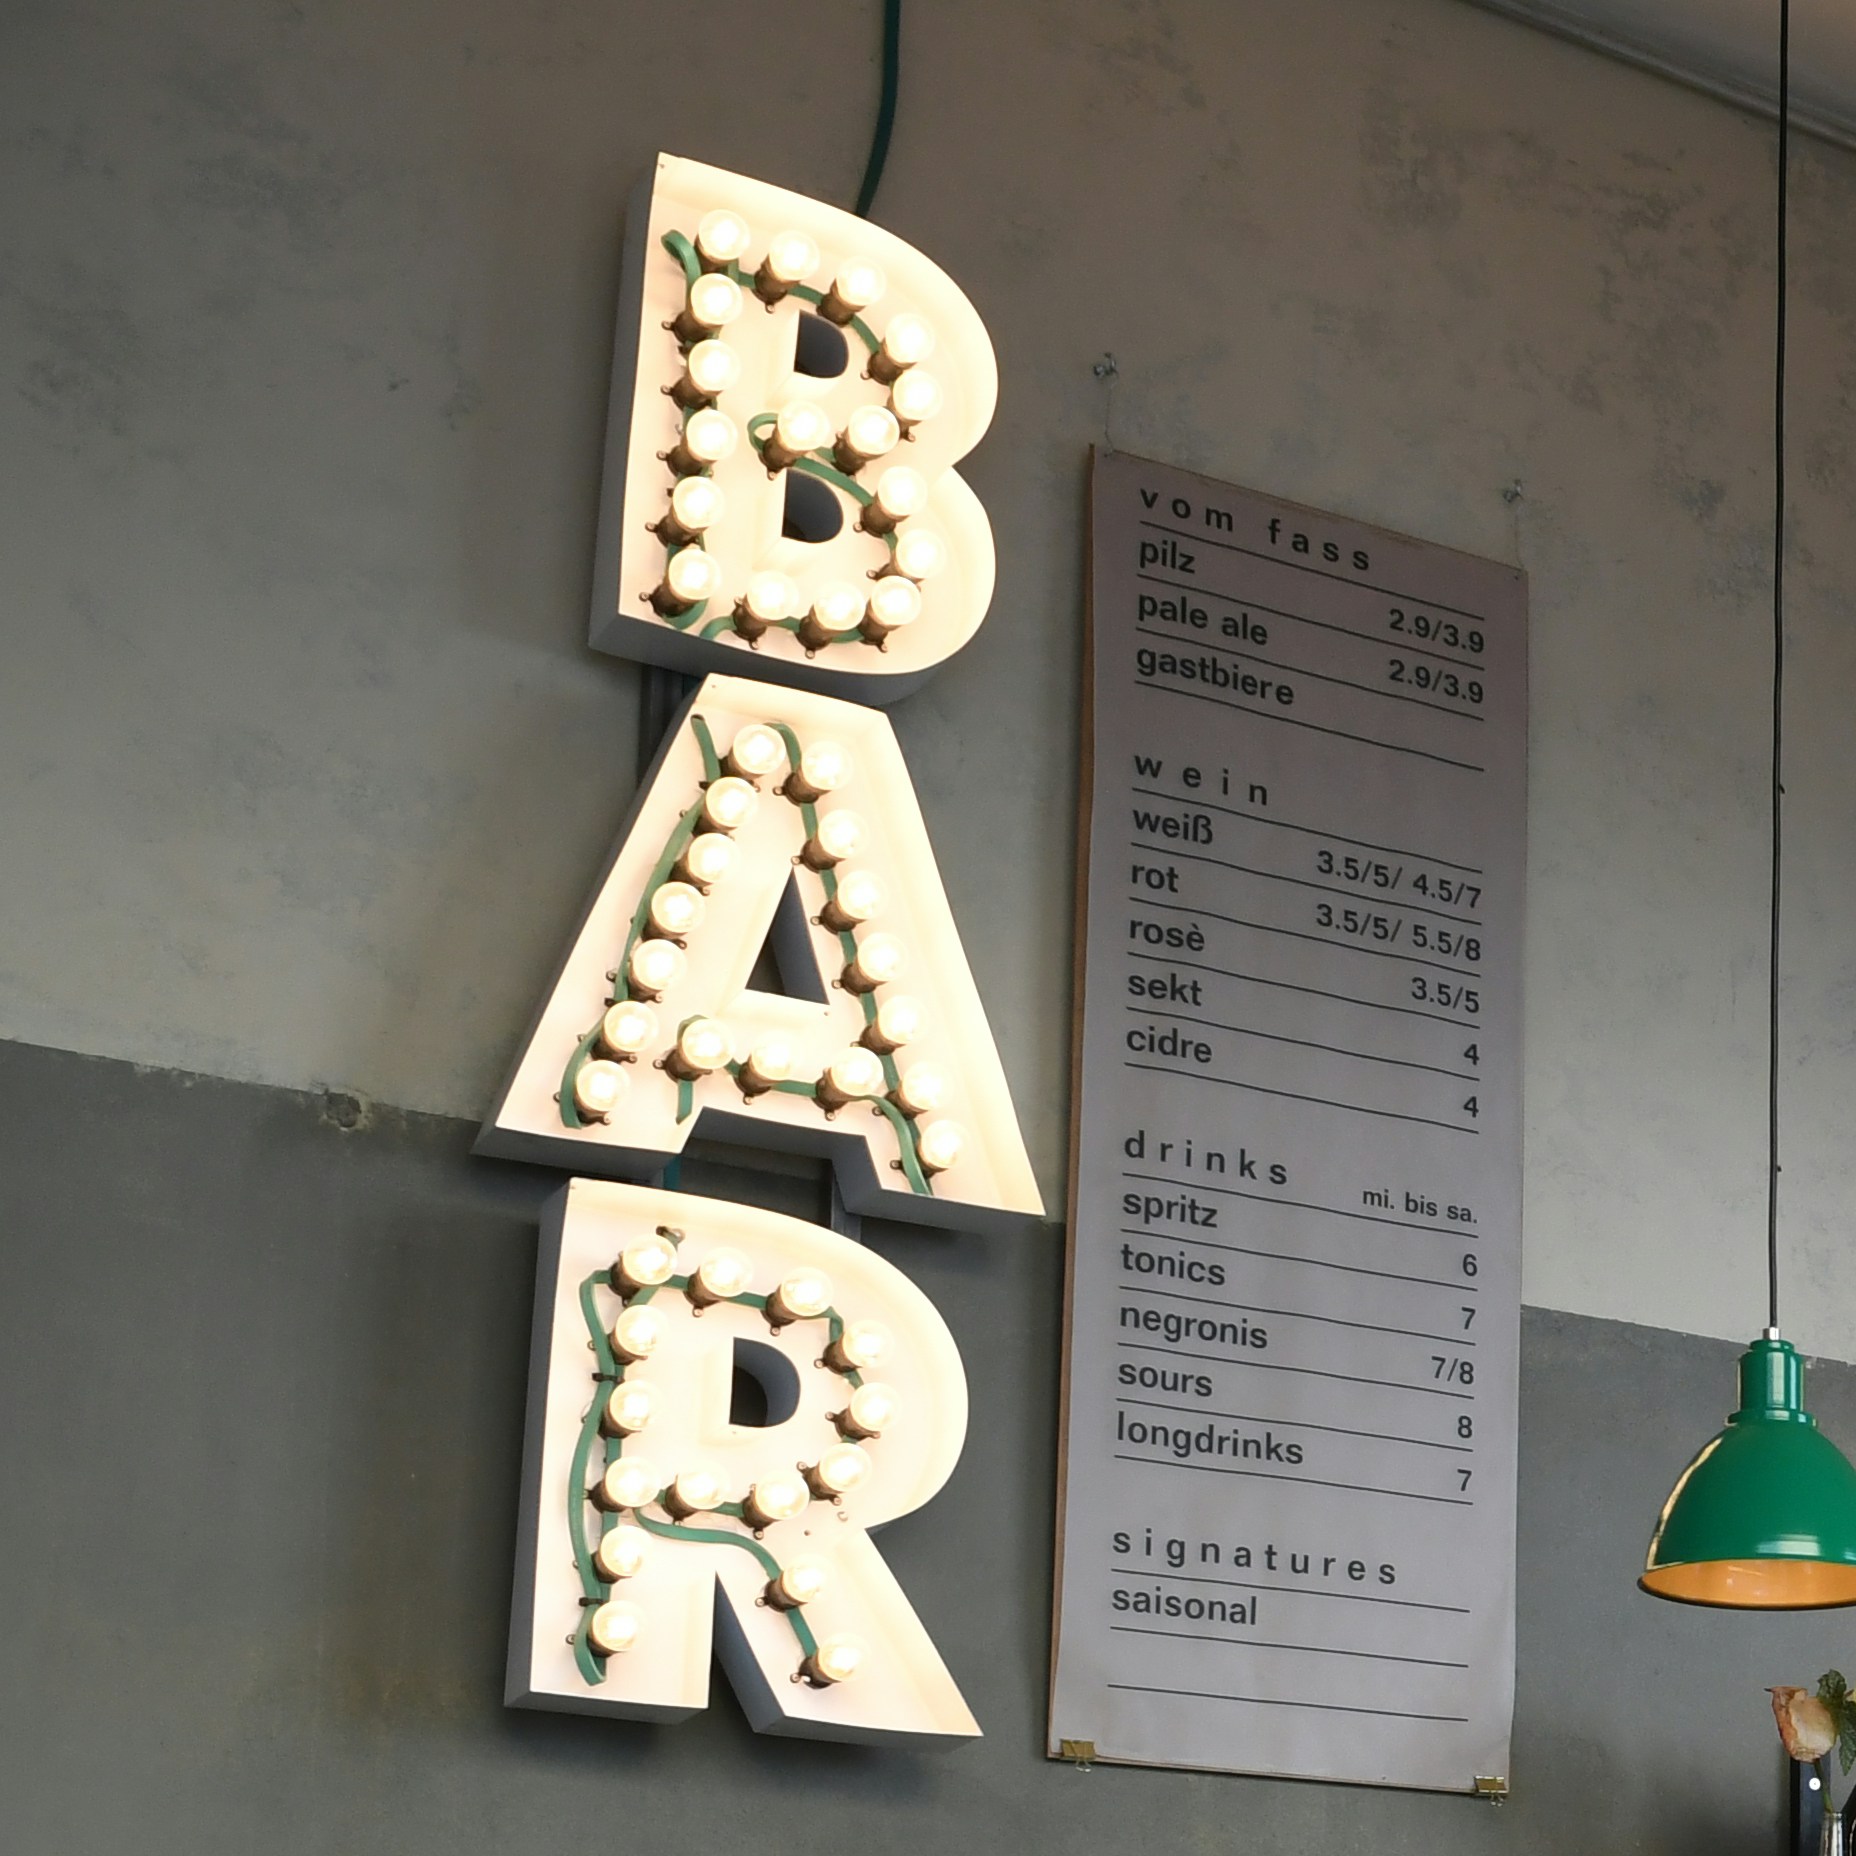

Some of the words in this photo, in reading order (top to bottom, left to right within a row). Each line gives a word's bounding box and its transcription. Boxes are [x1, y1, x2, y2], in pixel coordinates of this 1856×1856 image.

[1140, 487, 1234, 533] vom
[1267, 518, 1371, 571] fass
[1138, 537, 1196, 575] pilz
[1388, 607, 1486, 654] 2.9/3.9
[1135, 645, 1295, 705] gastbiere
[1137, 592, 1209, 630] pale
[1220, 611, 1269, 645] ale
[1387, 659, 1485, 704] 2.9/3.9
[1133, 753, 1269, 806] wein
[1132, 808, 1213, 844] weiß
[1412, 872, 1482, 909] 4.5/7
[490, 152, 1046, 1742] BAR
[1130, 863, 1180, 893] rot
[1411, 924, 1482, 963] 5.5/8
[1126, 972, 1203, 1006] sekt
[1462, 1042, 1480, 1067] 4
[1410, 976, 1481, 1014] 3.5/5
[1125, 1026, 1213, 1064] cidre
[1462, 1095, 1480, 1119] 4
[1122, 1130, 1289, 1186] drinks
[1362, 1186, 1396, 1211] mi.
[1404, 1191, 1439, 1217] bis
[1446, 1202, 1479, 1224] sa.
[1121, 1189, 1219, 1229] spritz
[1461, 1253, 1478, 1278] 6
[1120, 1243, 1227, 1287] tonics
[1460, 1307, 1477, 1331] 7
[1119, 1304, 1269, 1349] negronis
[1430, 1356, 1475, 1386] 7/8
[1117, 1361, 1214, 1398] sours
[1456, 1415, 1473, 1440] 8
[1116, 1411, 1305, 1466] longdrinks
[1456, 1469, 1473, 1493] 7
[1111, 1526, 1397, 1586] signatures
[1111, 1586, 1258, 1627] saisonal
